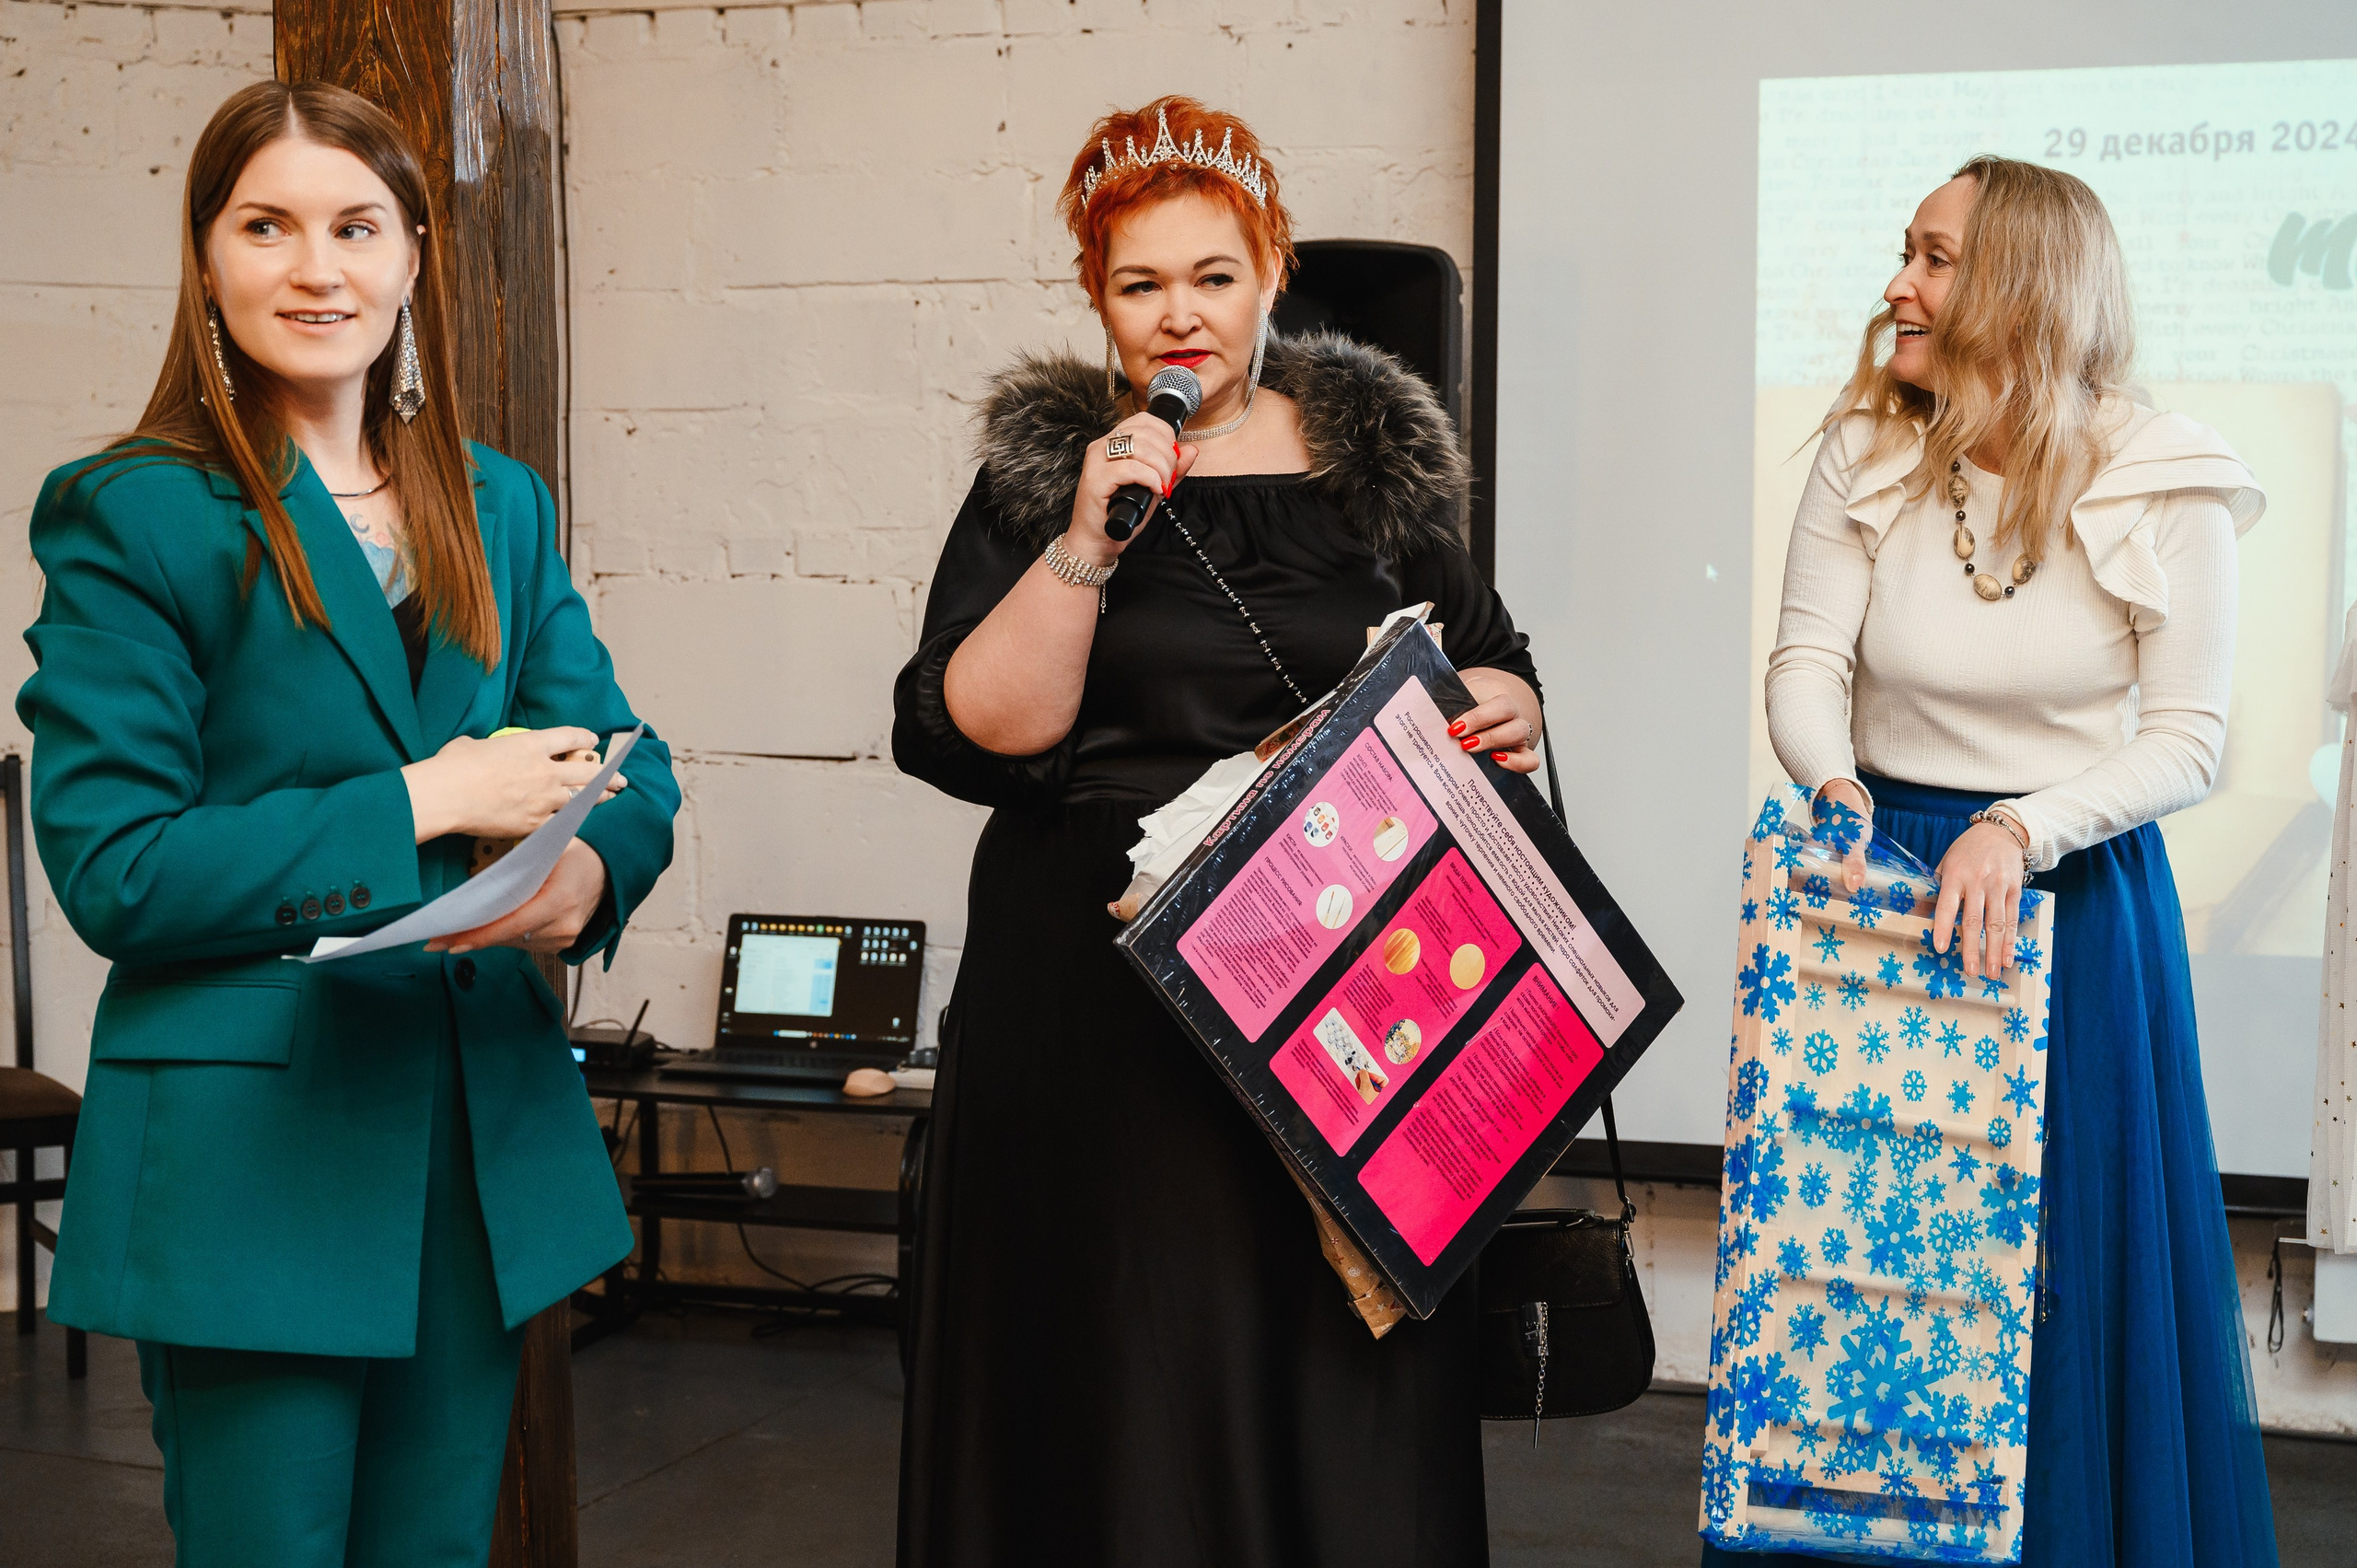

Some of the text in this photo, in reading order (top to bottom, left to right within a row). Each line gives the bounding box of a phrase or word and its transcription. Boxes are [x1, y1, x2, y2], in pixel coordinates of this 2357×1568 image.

[2043, 120, 2357, 162] 29 декабря 2024
[1202, 709, 1331, 846] Картина по номерам
[1364, 741, 1380, 763] СОСТАВ
[1263, 855, 1282, 879] ПРОЦЕСС
[1394, 713, 1408, 731] этого
[1433, 767, 1445, 783] Вам
[1441, 780, 1456, 799] всего
[1453, 797, 1466, 815] лишь
[1463, 811, 1493, 852] понадобится
[1490, 849, 1510, 876] емкость
[1510, 876, 1527, 898] водой
[1522, 894, 1533, 909] для
[1530, 905, 1545, 924] мытья
[1557, 943, 1570, 960] пара
[1567, 957, 1589, 987] салфеток
[1586, 983, 1596, 997] для
[1402, 710, 1436, 755] Раскрашивать
[1437, 761, 1459, 791] номерам
[1457, 788, 1471, 807] очень
[1469, 805, 1486, 829] просто
[1487, 830, 1512, 865] доставляет
[1509, 862, 1526, 883] массу
[1523, 880, 1553, 922] удовольствия!
[1550, 918, 1570, 945] Никаких
[1567, 942, 1595, 981] специальных
[1593, 977, 1611, 1003] навыков
[1608, 1000, 1619, 1014] для
[1457, 818, 1476, 842] чуточку
[1473, 841, 1494, 869] терпения
[1495, 871, 1515, 897] немного
[1512, 894, 1538, 930] свободного
[1466, 777, 1576, 932] Почувствуйте себя настоящим художником!
[1532, 974, 1557, 1009] ВНИМАНИЕ
